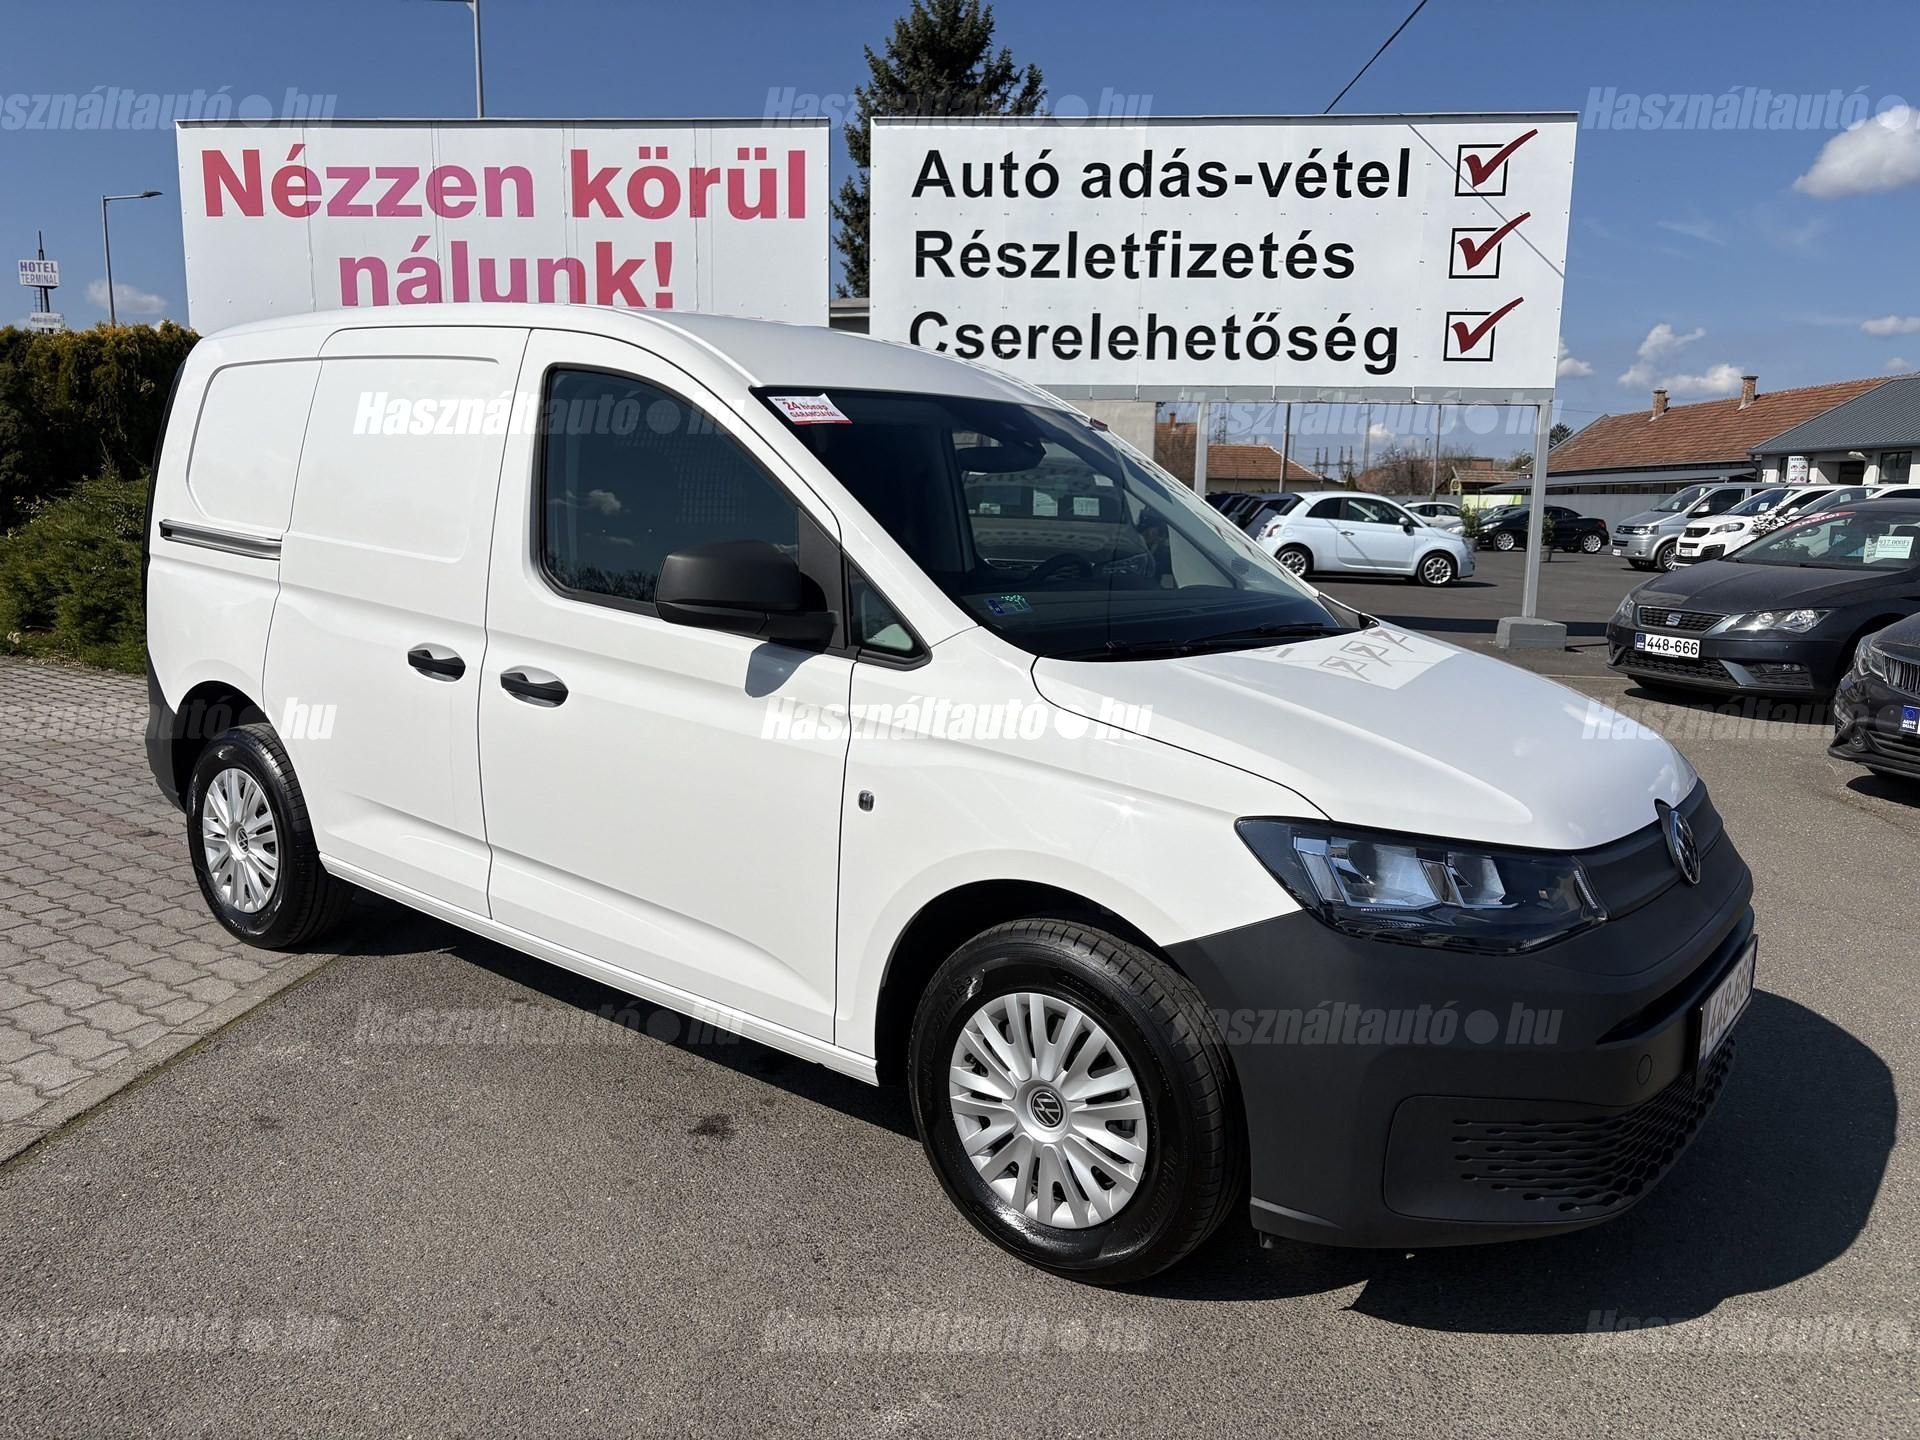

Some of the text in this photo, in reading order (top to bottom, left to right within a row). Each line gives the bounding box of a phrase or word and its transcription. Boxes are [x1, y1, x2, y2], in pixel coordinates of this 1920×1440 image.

[201, 144, 805, 220] Nézzen körül
[911, 148, 1410, 199] Autó adás-vétel
[20, 261, 57, 273] HOTEL
[21, 273, 58, 284] TERMINAL
[339, 235, 673, 308] nálunk!
[915, 229, 1355, 279] Részletfizetés
[909, 311, 1398, 375] Cserelehetőség
[1647, 636, 1699, 656] 448-666
